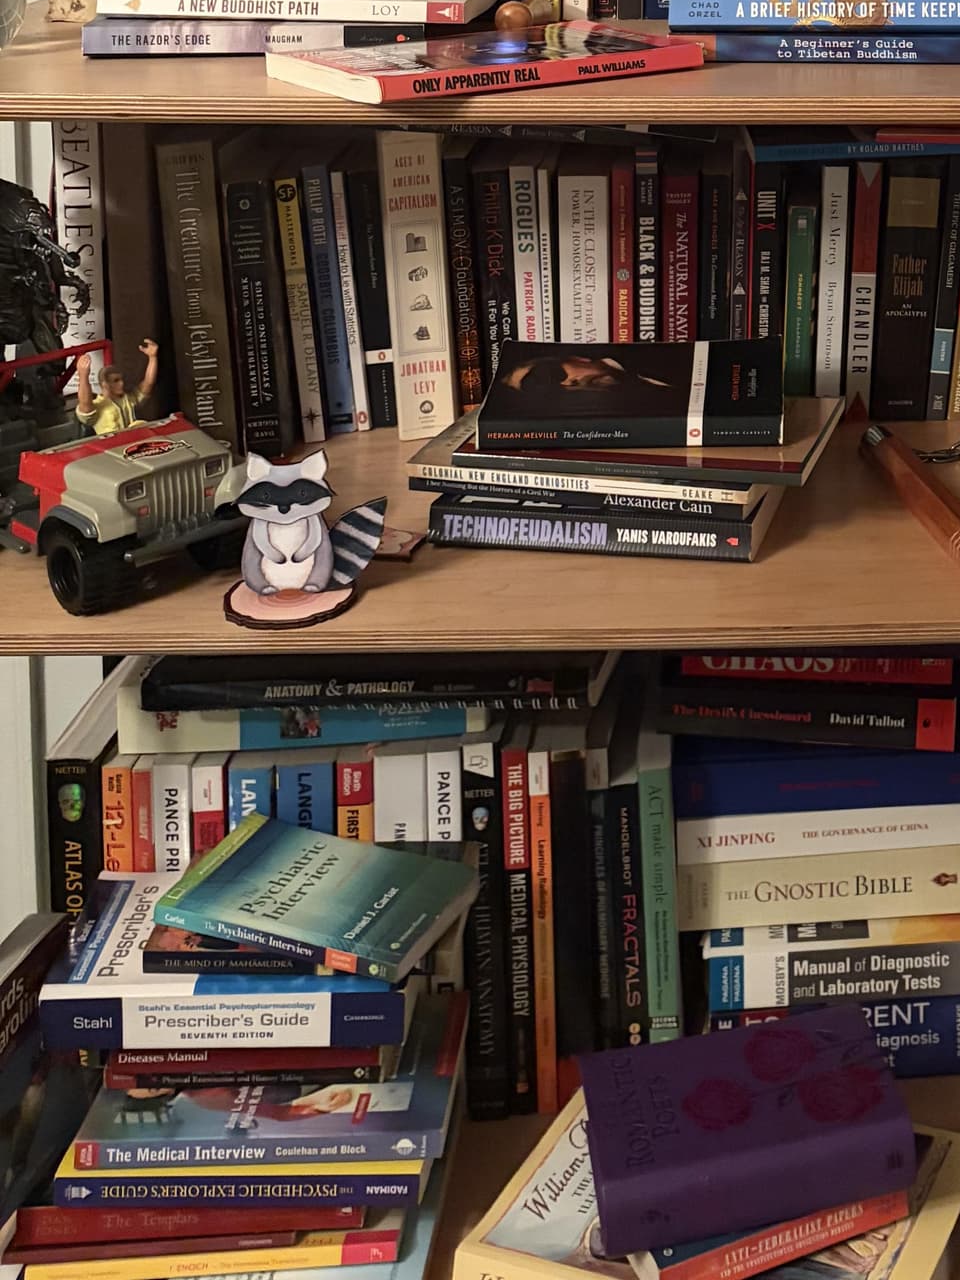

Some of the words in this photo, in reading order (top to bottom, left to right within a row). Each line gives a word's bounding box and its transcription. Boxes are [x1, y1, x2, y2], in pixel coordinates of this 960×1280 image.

[189, 0, 217, 13] NEW
[221, 0, 284, 14] BUDDHIST
[288, 1, 319, 15] PATH
[372, 4, 400, 16] LOY
[736, 3, 744, 17] A
[748, 3, 793, 17] BRIEF
[797, 2, 853, 17] HISTORY
[856, 3, 878, 17] OF
[882, 4, 917, 17] TIME
[112, 35, 132, 47] THE
[136, 34, 181, 46] RAZOR'S
[184, 34, 211, 45] EDGE
[265, 35, 302, 43] MAUGHAM
[389, 194, 437, 212] CAPITALISM
[514, 180, 534, 254] ROGUES
[852, 286, 871, 375] CHANDLER
[401, 360, 446, 377] JONATHAN
[413, 380, 436, 395] LEVY
[603, 494, 674, 510] Alexander
[679, 501, 712, 515] Cain
[443, 515, 607, 545] TECHNOFEUDALISM
[616, 527, 647, 544] YANIS
[651, 530, 717, 547] VAROUFAKIS
[697, 835, 713, 848] XI
[716, 832, 775, 847] JINPING
[726, 890, 750, 901] THE
[754, 880, 849, 903] GNOSTIC
[854, 876, 913, 896] BIBLE
[624, 894, 641, 1008] FRACTALS
[794, 959, 850, 976] Manual
[854, 958, 867, 971] of
[871, 953, 949, 972] Diagnostic
[794, 982, 816, 996] and
[819, 977, 898, 996] Laboratory
[902, 975, 940, 992] Tests
[73, 1016, 112, 1028] Stahl
[145, 1014, 254, 1028] Prescriber's
[260, 1014, 309, 1027] Guide
[232, 1031, 273, 1039] EDITION
[107, 1147, 132, 1162] The
[137, 1147, 190, 1161] Medical
[195, 1146, 266, 1160] Interview
